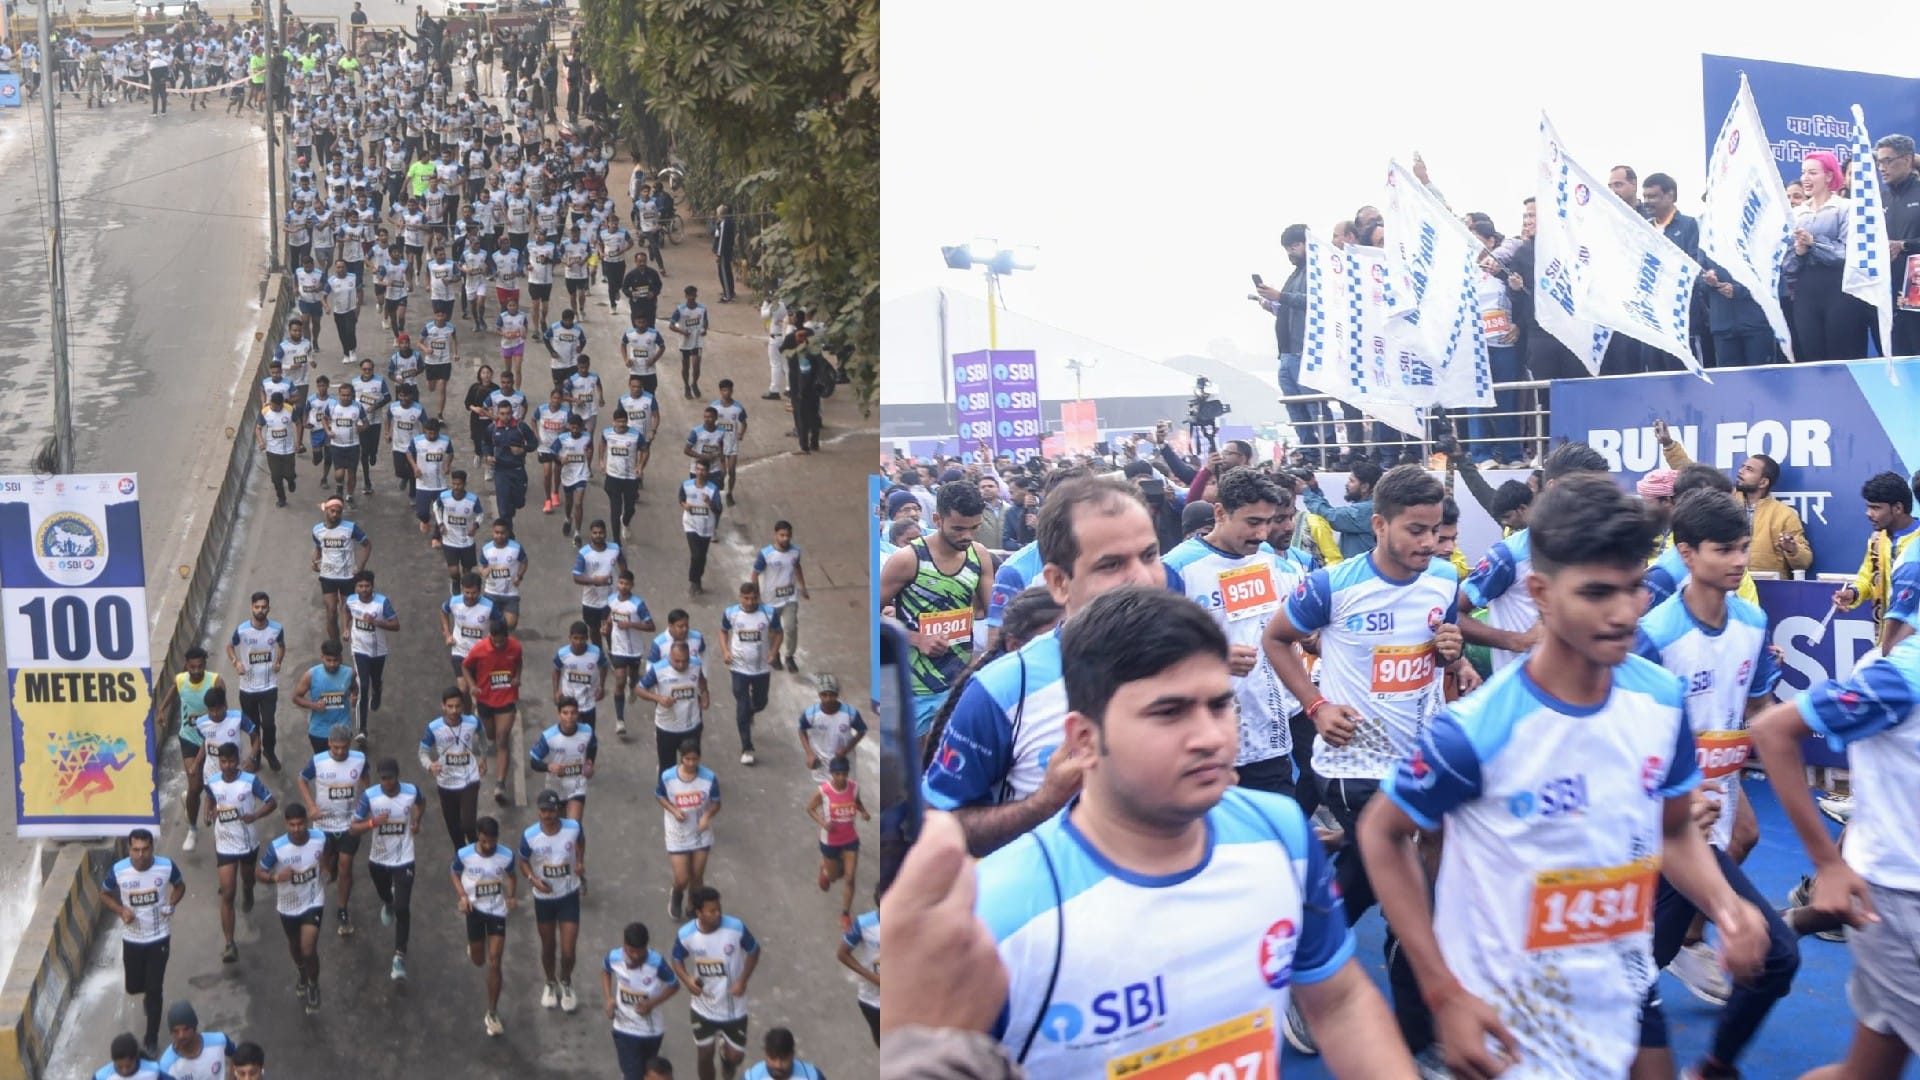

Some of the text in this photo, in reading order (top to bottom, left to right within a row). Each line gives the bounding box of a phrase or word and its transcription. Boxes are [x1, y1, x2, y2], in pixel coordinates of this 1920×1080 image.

[967, 363, 988, 382] SBI
[1009, 363, 1035, 381] SBI
[969, 391, 990, 410] SBI
[1011, 391, 1037, 408] SBI
[971, 419, 993, 438] SBI
[1013, 419, 1039, 437] SBI
[1588, 419, 1831, 472] RUN FOR
[5, 482, 21, 491] SBI
[67, 560, 82, 569] SBI
[1228, 578, 1266, 603] 9570
[19, 595, 135, 662] 100
[925, 617, 967, 636] 10301
[1366, 612, 1395, 632] SBI
[1379, 653, 1433, 683] 9025
[25, 671, 137, 703] METERS
[1690, 668, 1716, 693] SBI
[1539, 773, 1589, 817] SBI
[131, 892, 156, 905] 6262
[1541, 882, 1640, 932] 1431
[1092, 975, 1166, 1035] SBI
